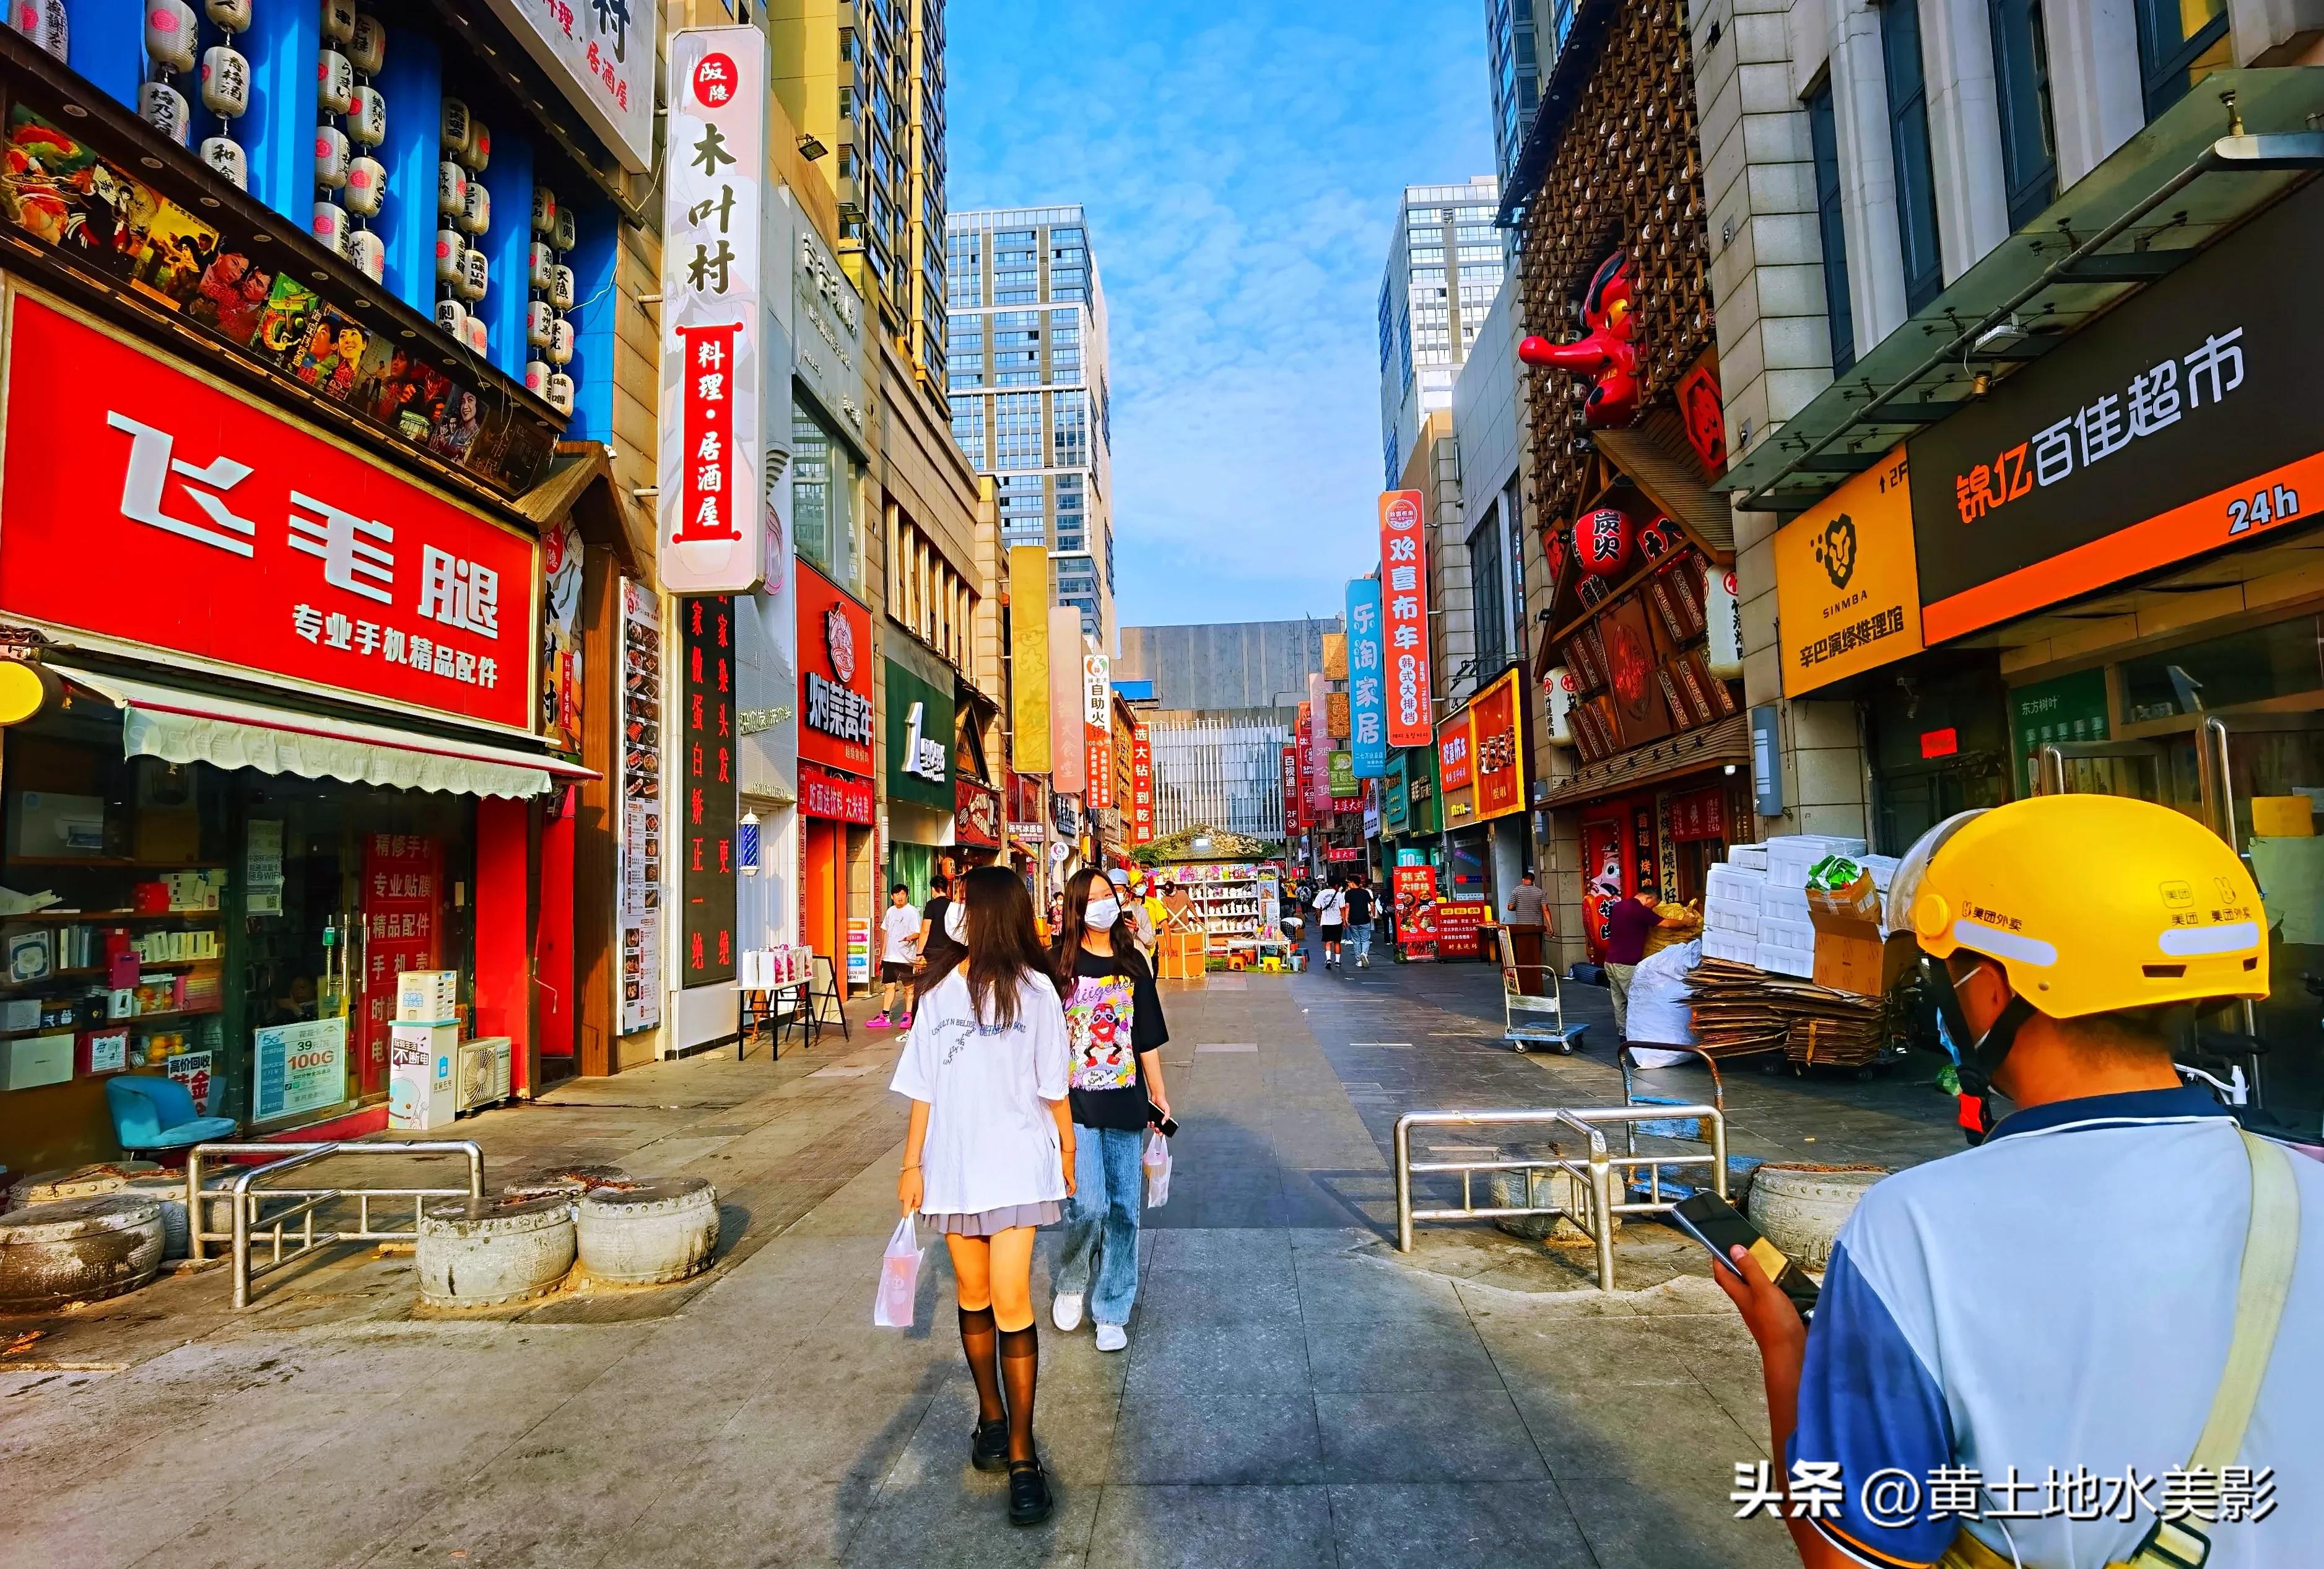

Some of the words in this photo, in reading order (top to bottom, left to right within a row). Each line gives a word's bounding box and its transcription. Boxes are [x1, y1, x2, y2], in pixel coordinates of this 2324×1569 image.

[699, 62, 729, 102] 阪隐
[687, 123, 737, 295] 木叶村
[1957, 326, 2244, 524] 锦亿百佳超市
[1890, 460, 1907, 488] 2F
[107, 410, 498, 639] 飞毛腿
[2227, 483, 2299, 536] 24h
[1593, 512, 1621, 562] 炭火
[1390, 535, 1419, 650] 欢喜布车
[1823, 590, 1868, 619] SINMBA
[293, 604, 498, 689] 专业手机精品配件
[1800, 605, 1905, 668] 辛巴演绎推理馆
[1353, 602, 1380, 744] 乐淘家居
[1401, 657, 1416, 723] 韩式大排档
[2021, 694, 2058, 715] 东方树叶
[1091, 684, 1106, 738] 自助火锅
[1284, 756, 1295, 787] 百视通
[373, 872, 433, 898] 专业贴膜
[1401, 871, 1427, 881] 韩式
[1401, 883, 1430, 891] 大排档
[373, 912, 430, 938] 精品配件
[1973, 906, 2022, 932] 美团外卖
[2171, 912, 2199, 925] 美团
[2211, 906, 2253, 923] 美团外卖
[170, 1055, 210, 1073] 高价回收
[287, 1050, 334, 1070] 100G
[394, 1048, 429, 1065] 不断电
